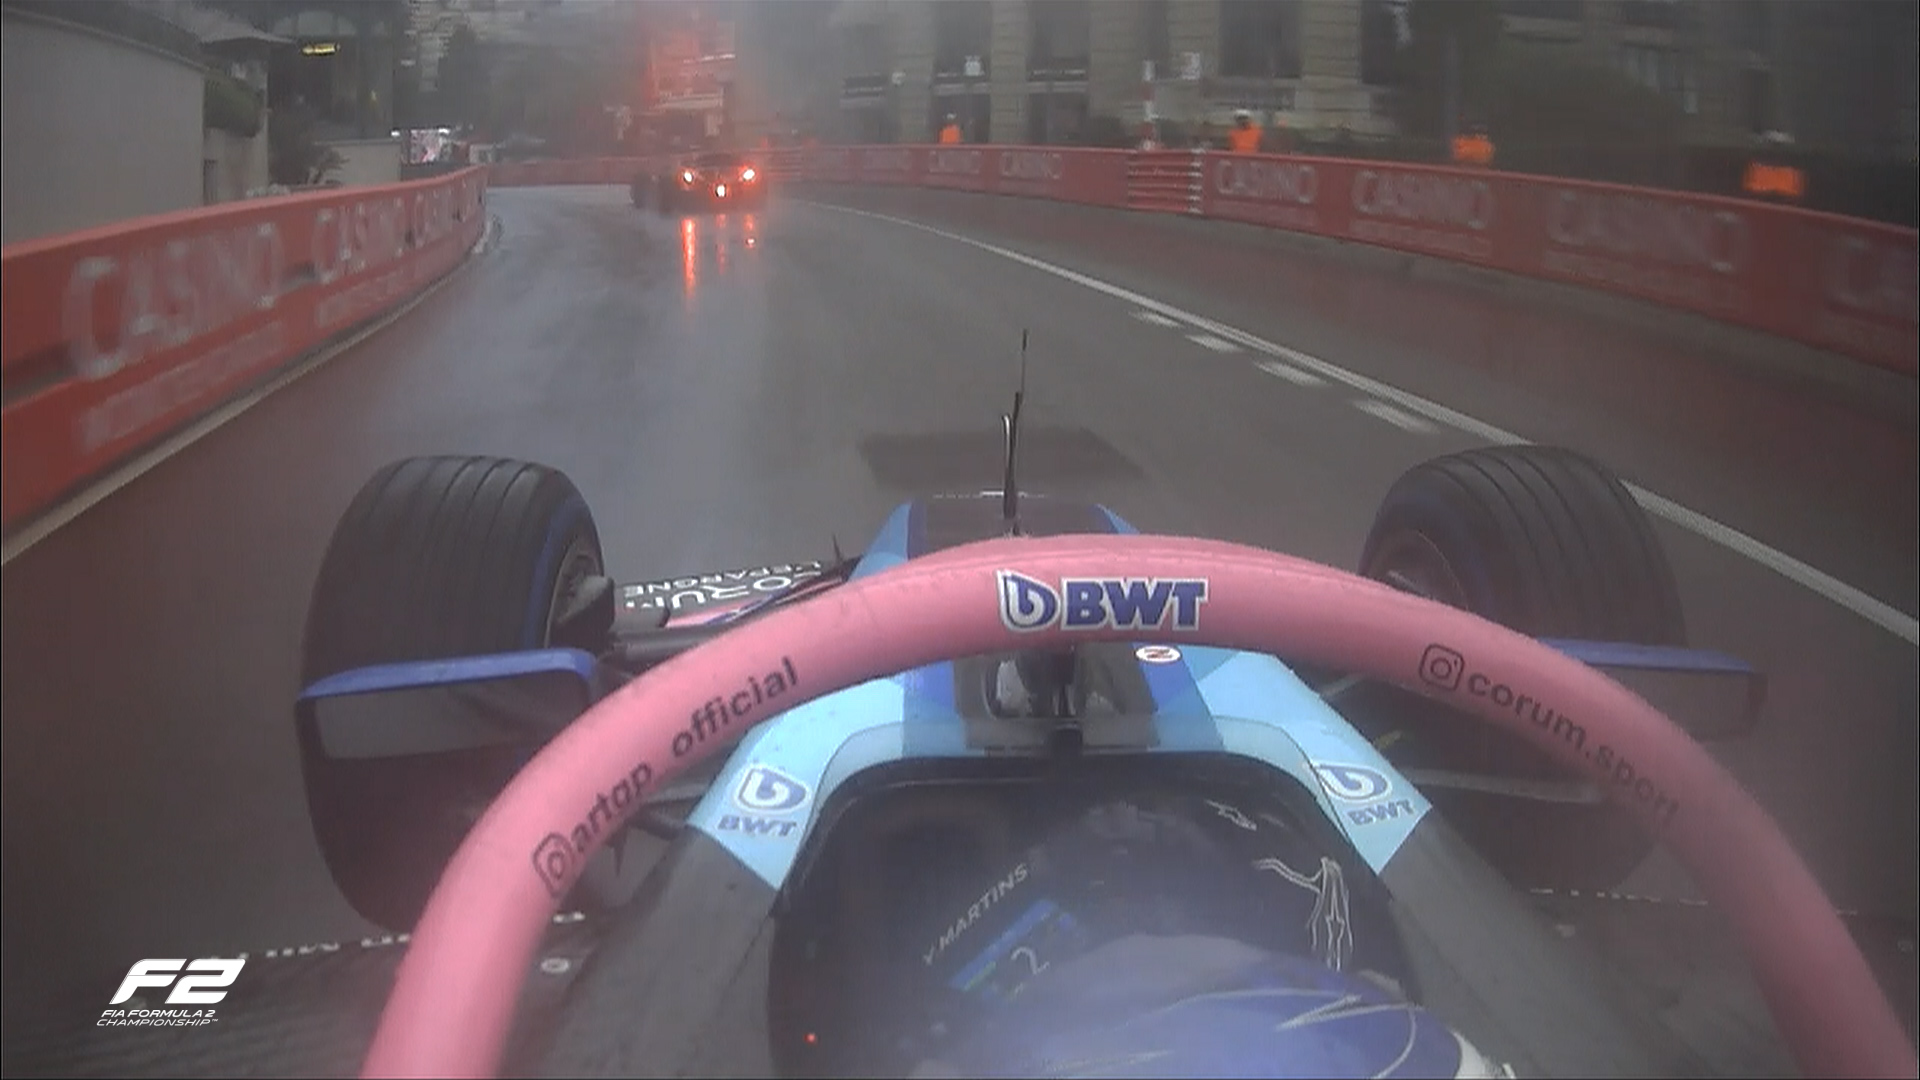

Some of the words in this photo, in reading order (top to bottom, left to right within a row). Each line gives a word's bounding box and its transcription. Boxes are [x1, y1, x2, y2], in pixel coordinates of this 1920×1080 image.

[1216, 159, 1317, 203] CASINO
[1354, 170, 1491, 230] CASINO
[62, 222, 284, 381] CASINO
[1062, 578, 1207, 630] BWT
[717, 814, 797, 836] BWT
[1347, 799, 1414, 825] BWT
[939, 863, 1028, 951] MARTINS
[1011, 946, 1050, 975] 2
